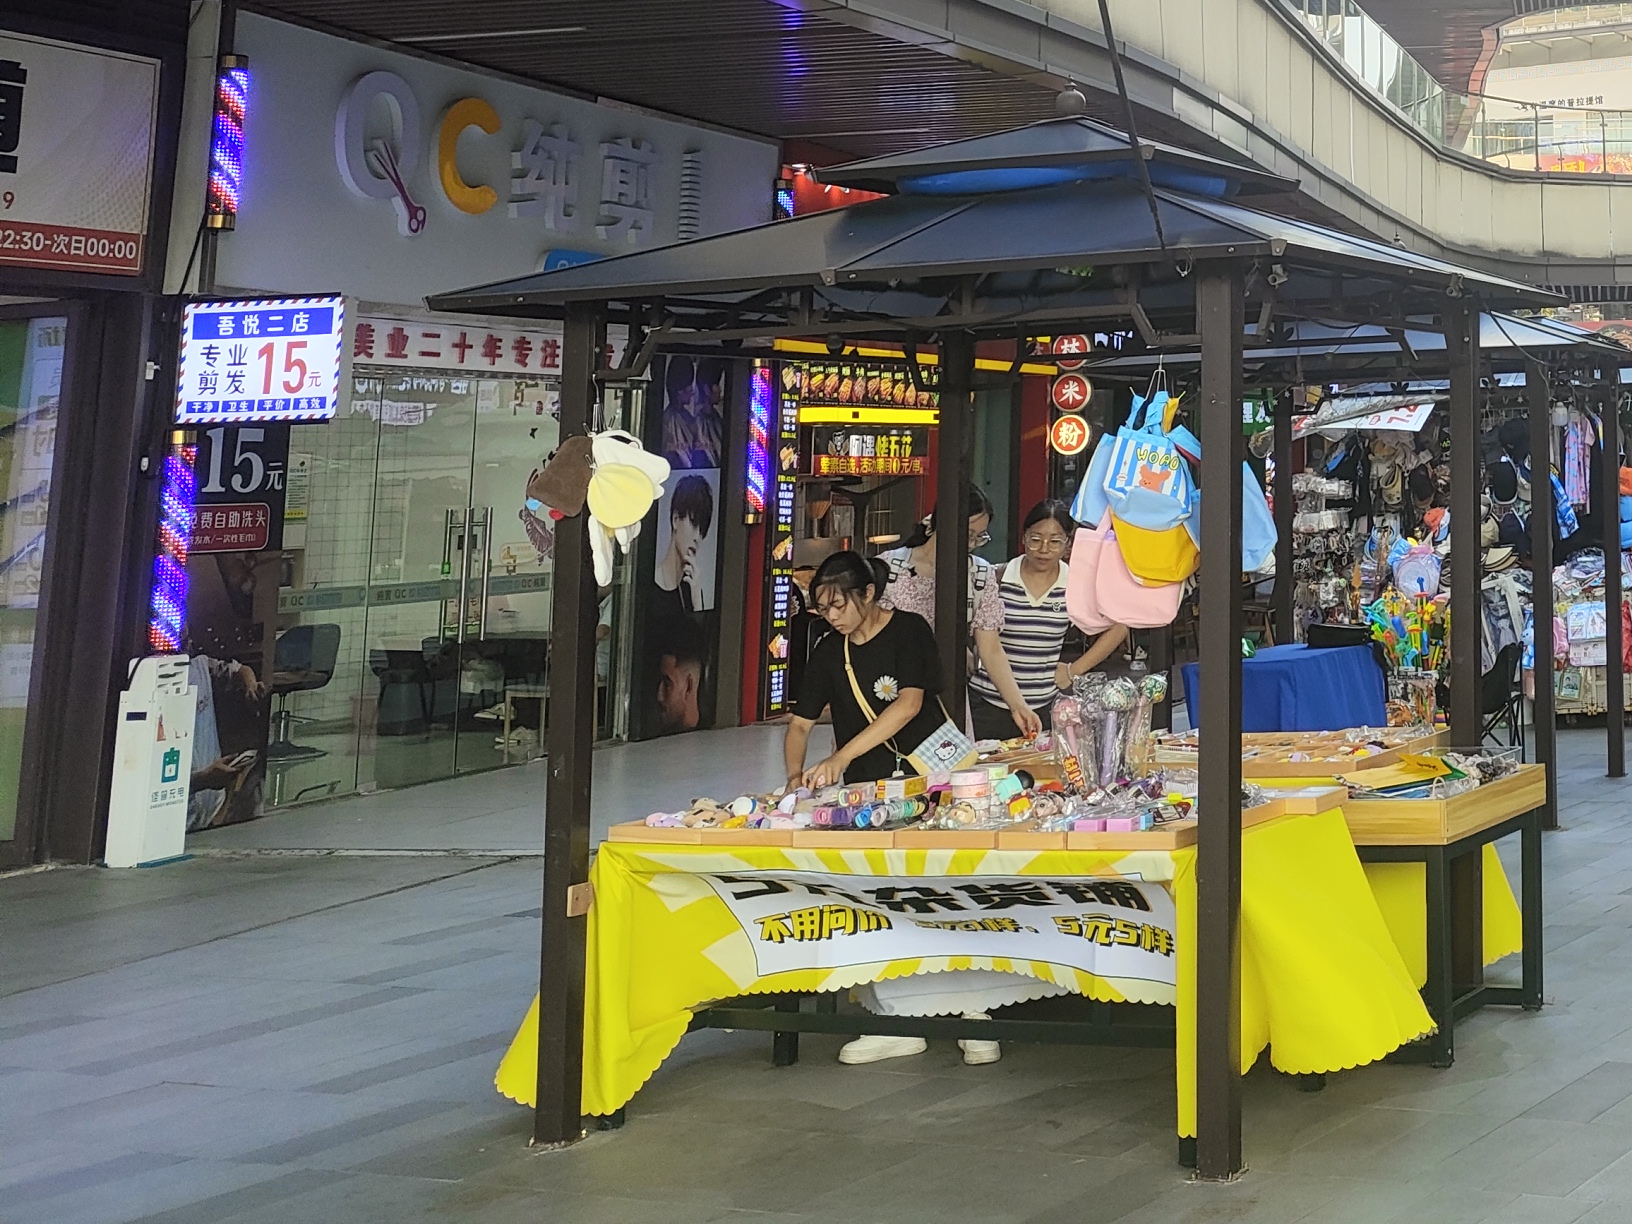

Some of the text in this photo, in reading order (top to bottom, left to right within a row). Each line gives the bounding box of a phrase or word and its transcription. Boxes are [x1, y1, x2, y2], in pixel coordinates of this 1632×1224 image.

[0, 229, 137, 260] 2:30-次日00:00
[217, 312, 310, 336] 吾悦二店
[200, 343, 249, 368] 专业
[197, 369, 246, 396] 剪发
[191, 397, 321, 413] 干净 卫生 平价 高效
[754, 904, 893, 943] 不用问价
